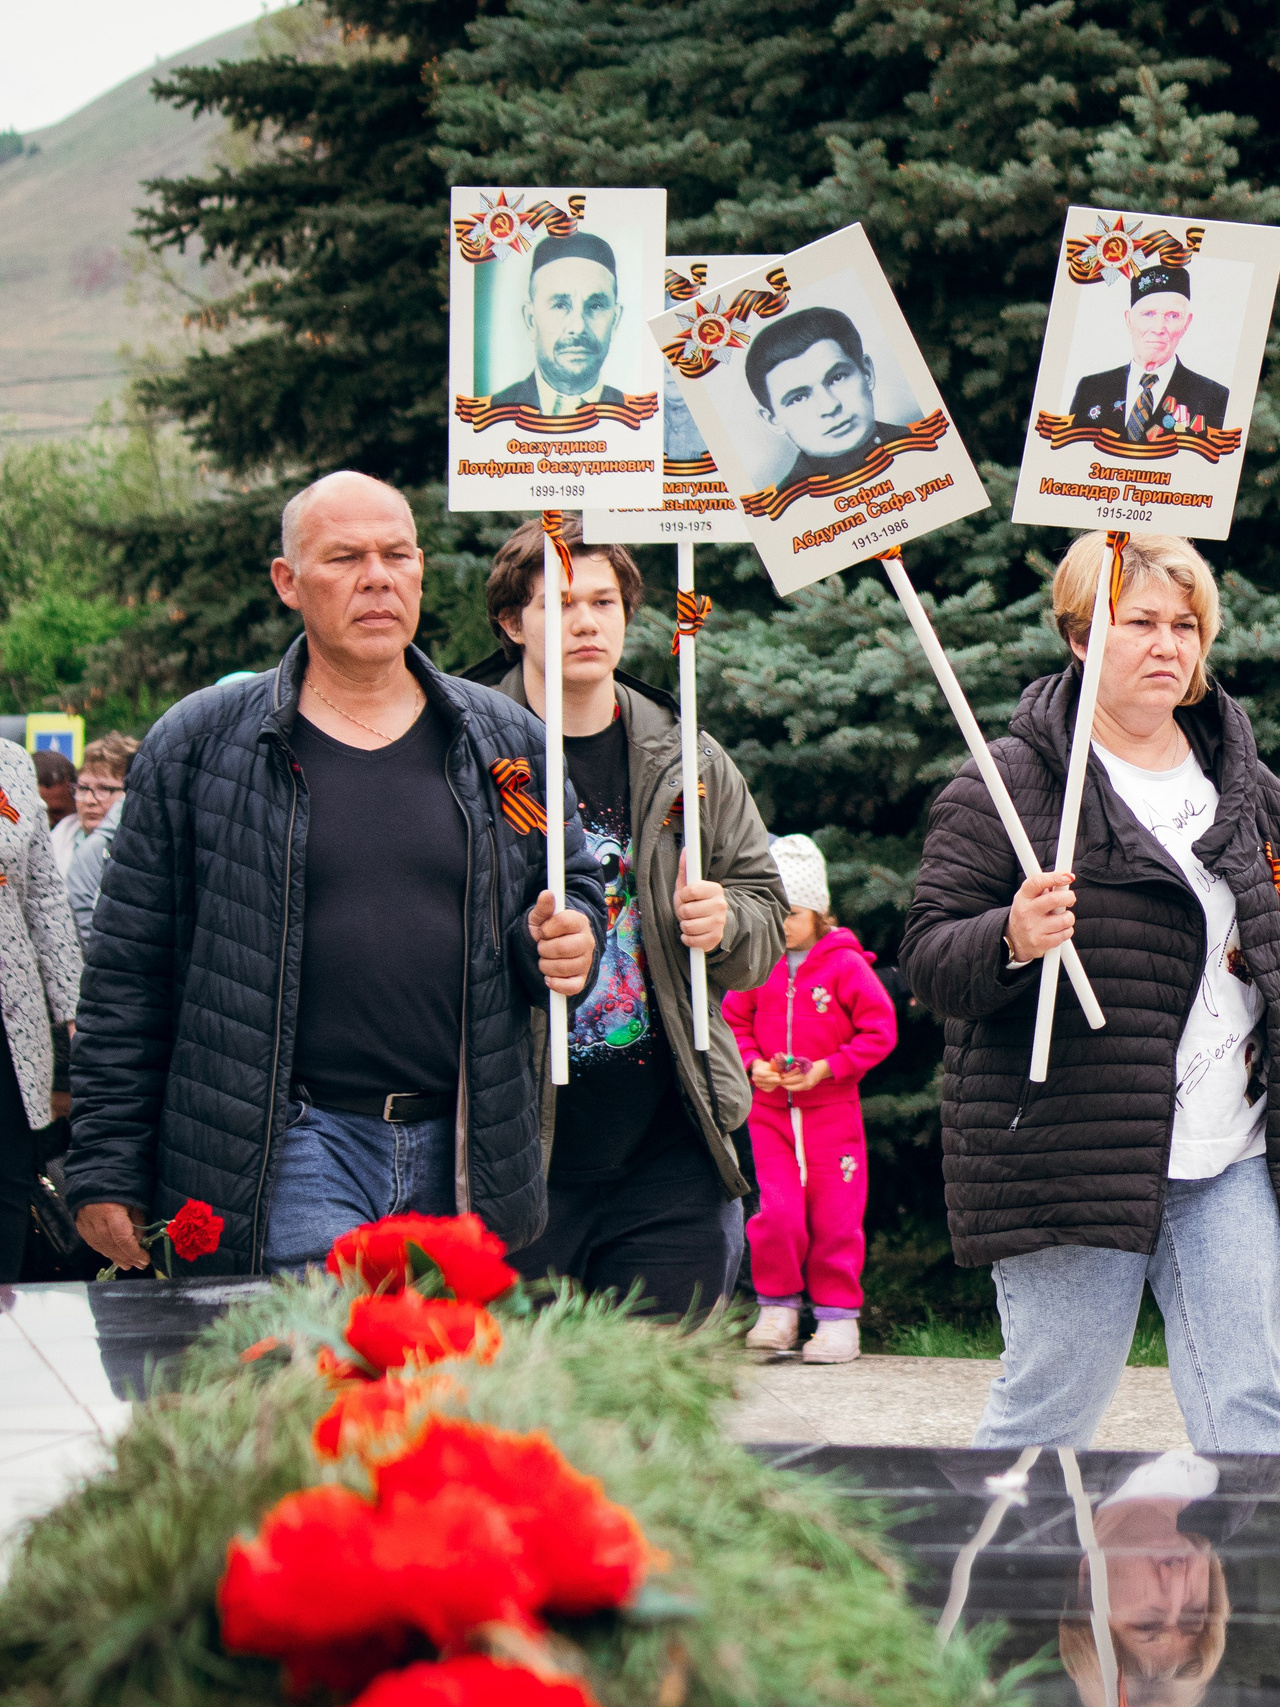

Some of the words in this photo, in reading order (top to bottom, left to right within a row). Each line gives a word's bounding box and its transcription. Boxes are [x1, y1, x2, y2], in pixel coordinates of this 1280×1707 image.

[507, 439, 607, 456] Фасхутдинов
[458, 459, 534, 477] Лотфулла
[537, 458, 655, 476] Фасхутдинович
[1088, 462, 1171, 485] Зиганшин
[530, 485, 585, 496] 1899-1989
[834, 479, 895, 512] Сафин
[1039, 477, 1120, 503] Искандар
[1122, 485, 1213, 508] Гарипович
[792, 512, 867, 554] Абдулла
[866, 490, 917, 519] Сафа
[915, 473, 954, 501] улы
[1096, 506, 1153, 521] 1915-2002
[660, 521, 712, 531] 1919-1975
[851, 518, 909, 550] 1913-1986
